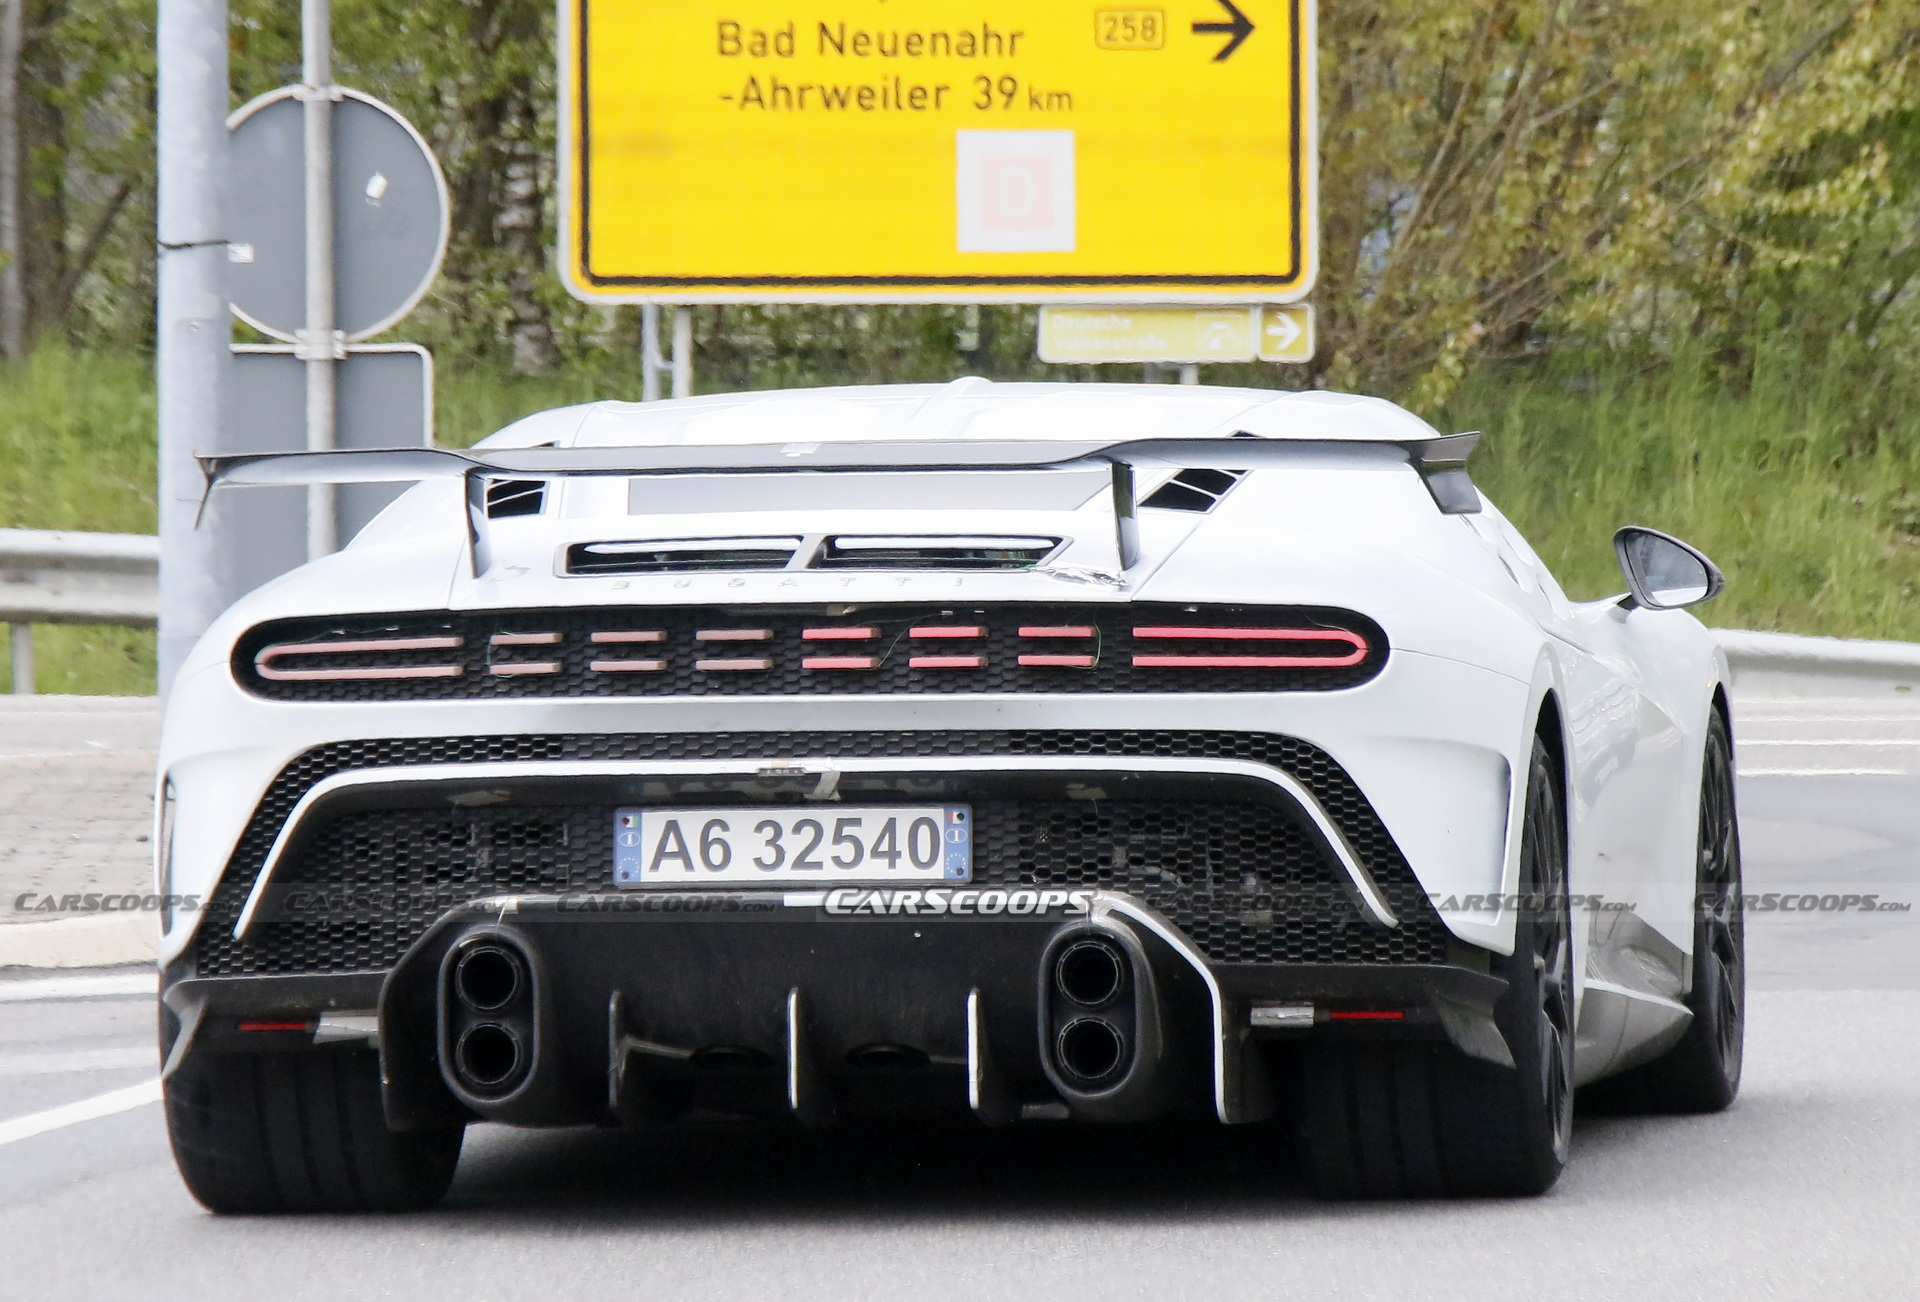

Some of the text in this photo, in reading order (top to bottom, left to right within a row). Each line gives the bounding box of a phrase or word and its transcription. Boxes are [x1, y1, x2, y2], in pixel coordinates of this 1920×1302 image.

[717, 20, 1025, 59] Bad Neuenahr
[1103, 14, 1156, 42] 258
[718, 74, 1074, 113] -Ahrweiler 39 km
[612, 577, 963, 589] BUGATTI
[648, 817, 941, 873] A6 32540
